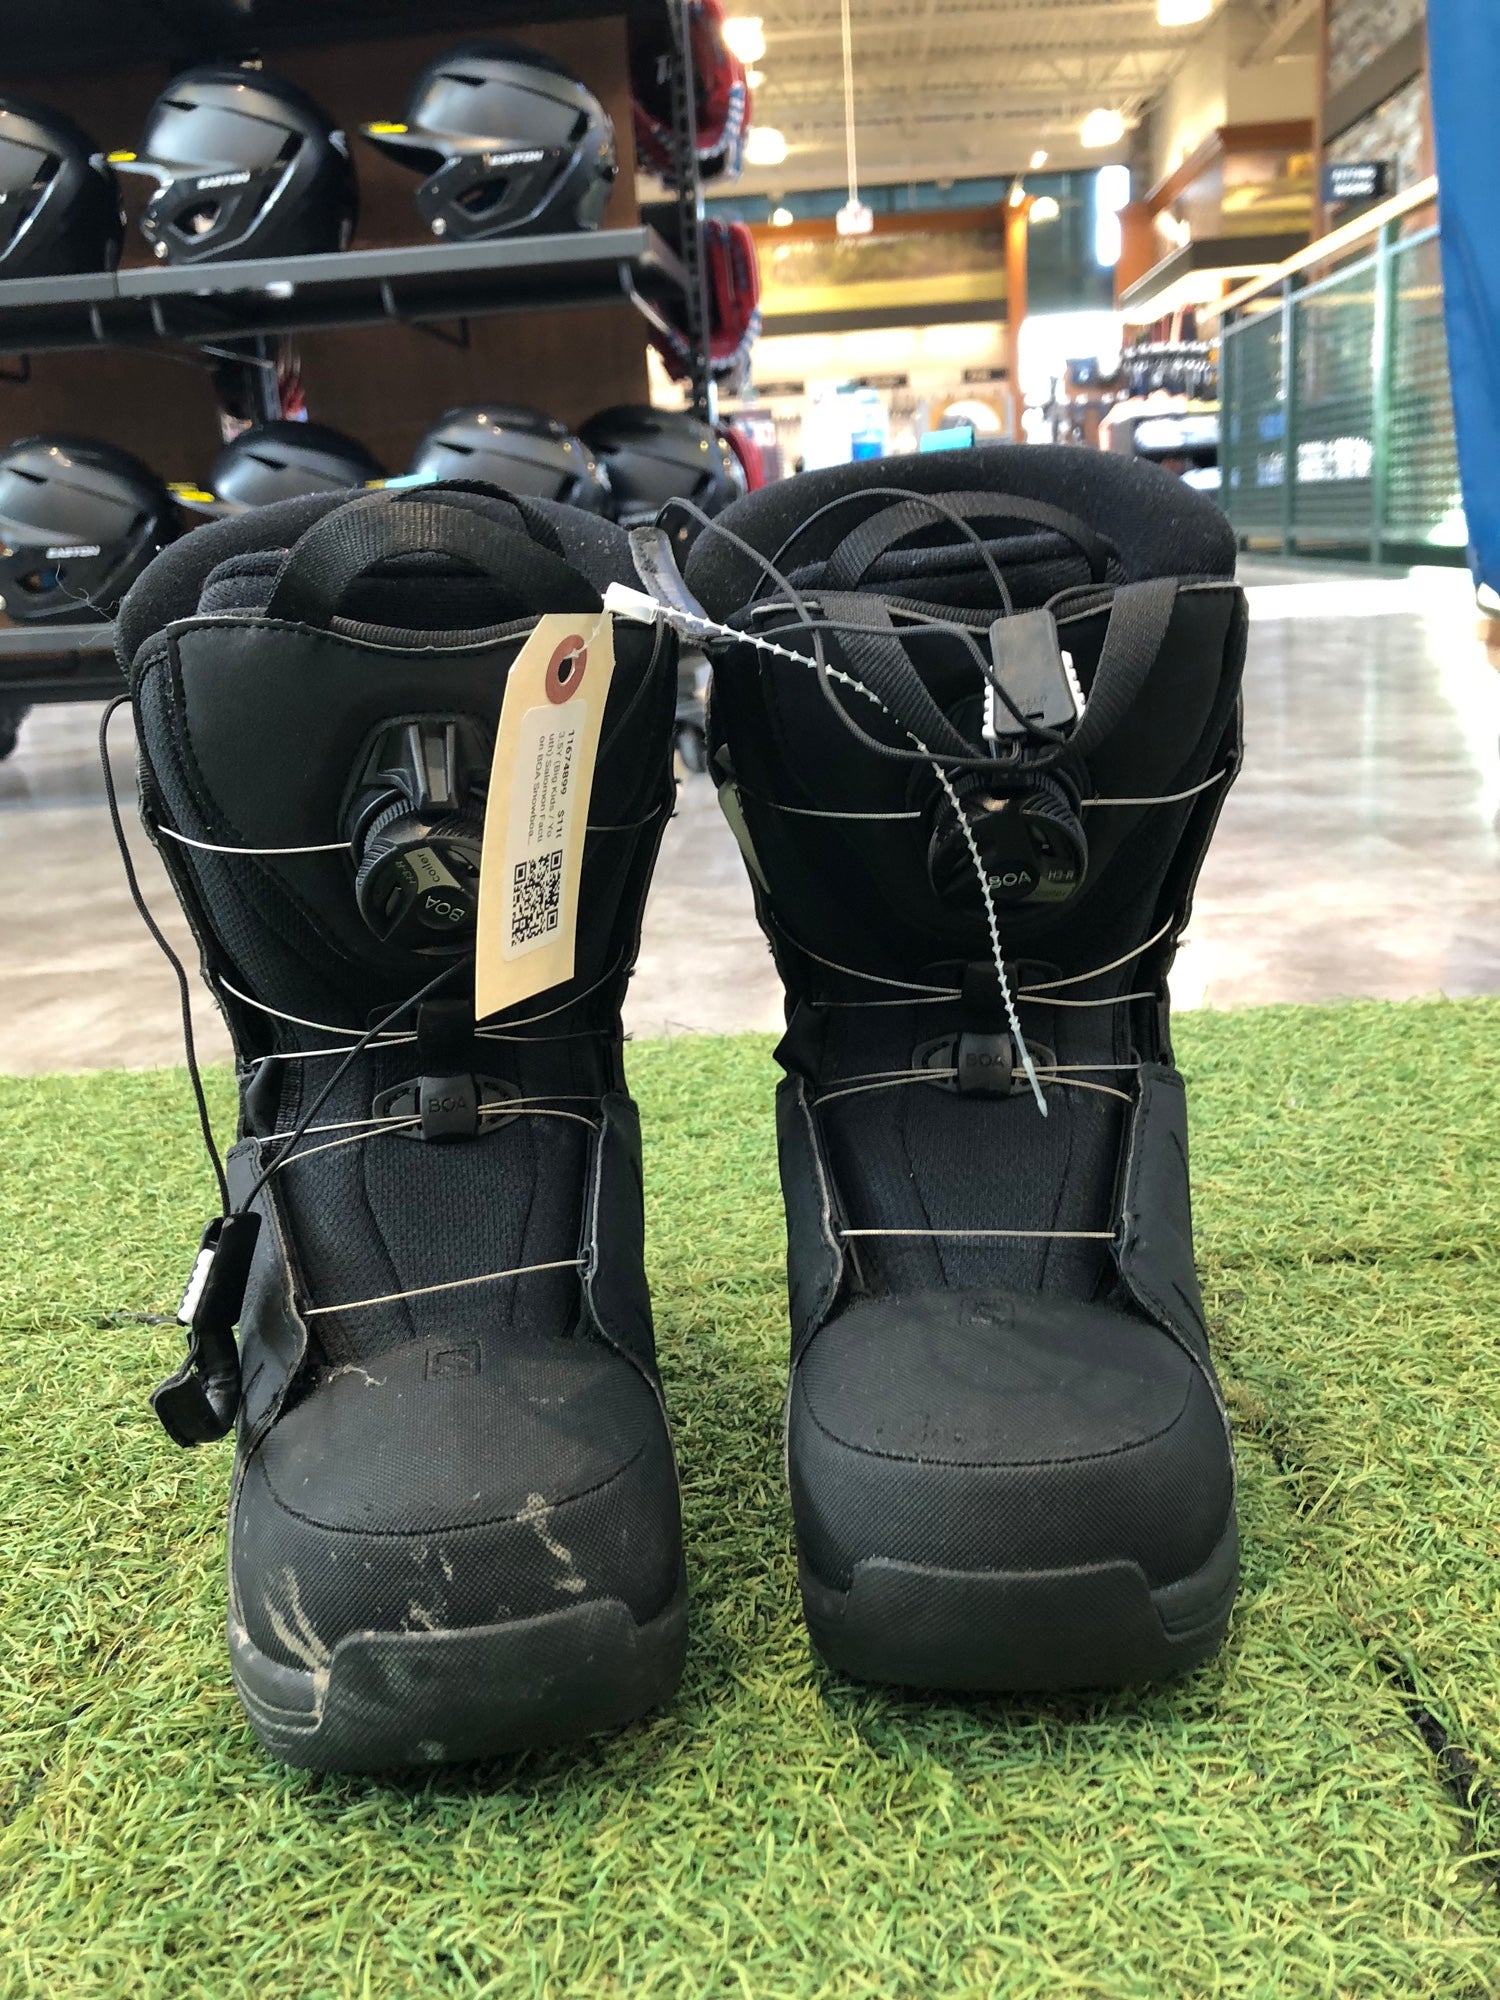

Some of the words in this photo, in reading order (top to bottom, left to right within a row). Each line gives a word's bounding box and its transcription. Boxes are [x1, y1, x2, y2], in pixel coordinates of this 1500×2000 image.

[539, 735, 545, 751] on
[546, 733, 554, 757] uth)
[557, 731, 565, 756] 3.5Y
[535, 754, 543, 780] BOA
[551, 760, 561, 783] (Big
[561, 730, 574, 795] 11674899
[541, 759, 551, 811] Salomon
[549, 787, 557, 811] Kids
[547, 822, 554, 838] Yo
[417, 853, 440, 883] coiler
[988, 870, 1032, 889] BOA
[425, 895, 465, 921] BOA
[966, 1053, 1004, 1068] BOA
[428, 1097, 467, 1114] BOA
